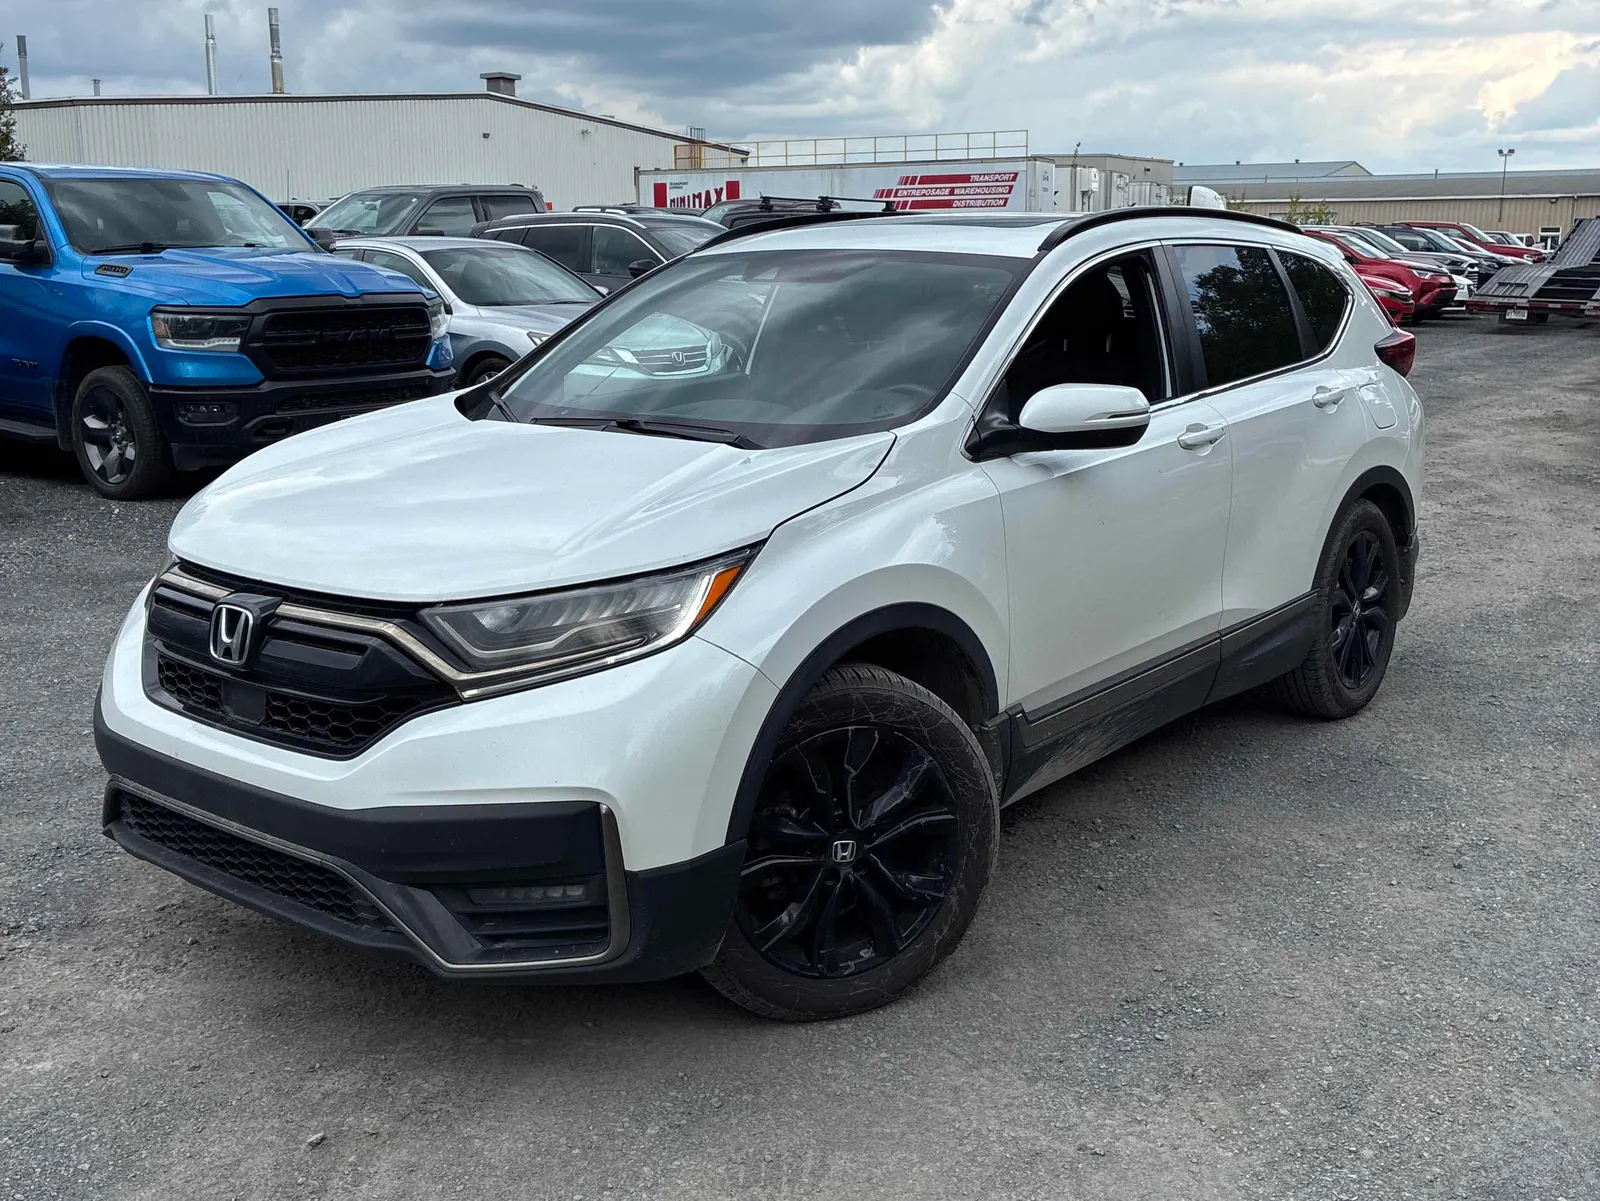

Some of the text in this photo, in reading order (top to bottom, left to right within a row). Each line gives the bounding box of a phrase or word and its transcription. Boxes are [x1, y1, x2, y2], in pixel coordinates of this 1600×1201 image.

[969, 174, 1015, 182] TRANSPORT
[897, 186, 1010, 197] ENTREPOSAGE WAREHOUSING
[669, 187, 724, 208] MINIMAX
[952, 199, 1005, 208] DISTRIBUTION
